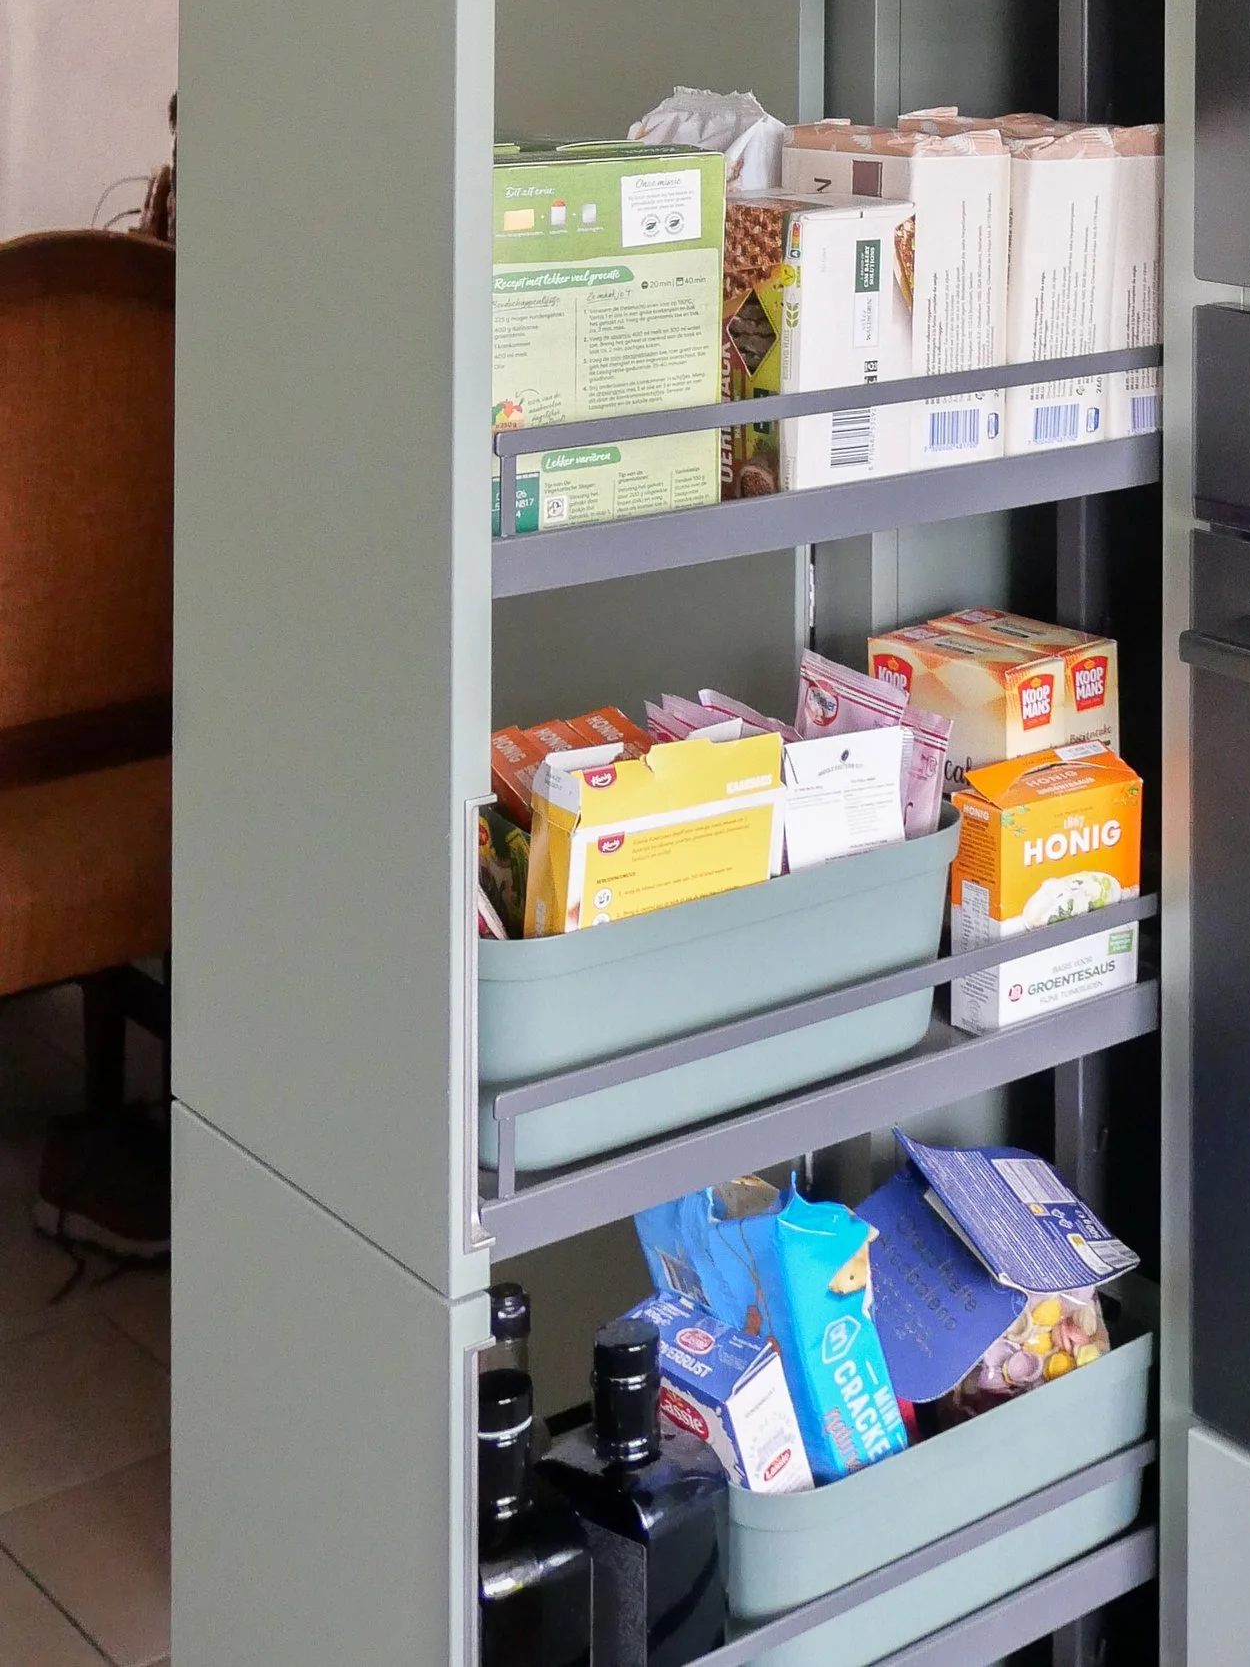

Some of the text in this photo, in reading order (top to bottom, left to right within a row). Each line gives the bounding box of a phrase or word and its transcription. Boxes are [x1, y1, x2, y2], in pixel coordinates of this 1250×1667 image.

[694, 276, 707, 284] min
[877, 666, 908, 690] KOOP
[1075, 666, 1103, 686] KOOP
[1021, 685, 1051, 705] KOOP
[1076, 682, 1104, 701] MANS
[1022, 700, 1050, 720] MANS
[536, 727, 573, 751] HONIG
[586, 714, 624, 742] HONIG
[491, 734, 527, 764] HONIG
[963, 804, 990, 821] HONIG
[1023, 820, 1122, 867] HONIG
[1027, 960, 1116, 996] GROENTESAUS
[873, 1385, 902, 1432] MINI
